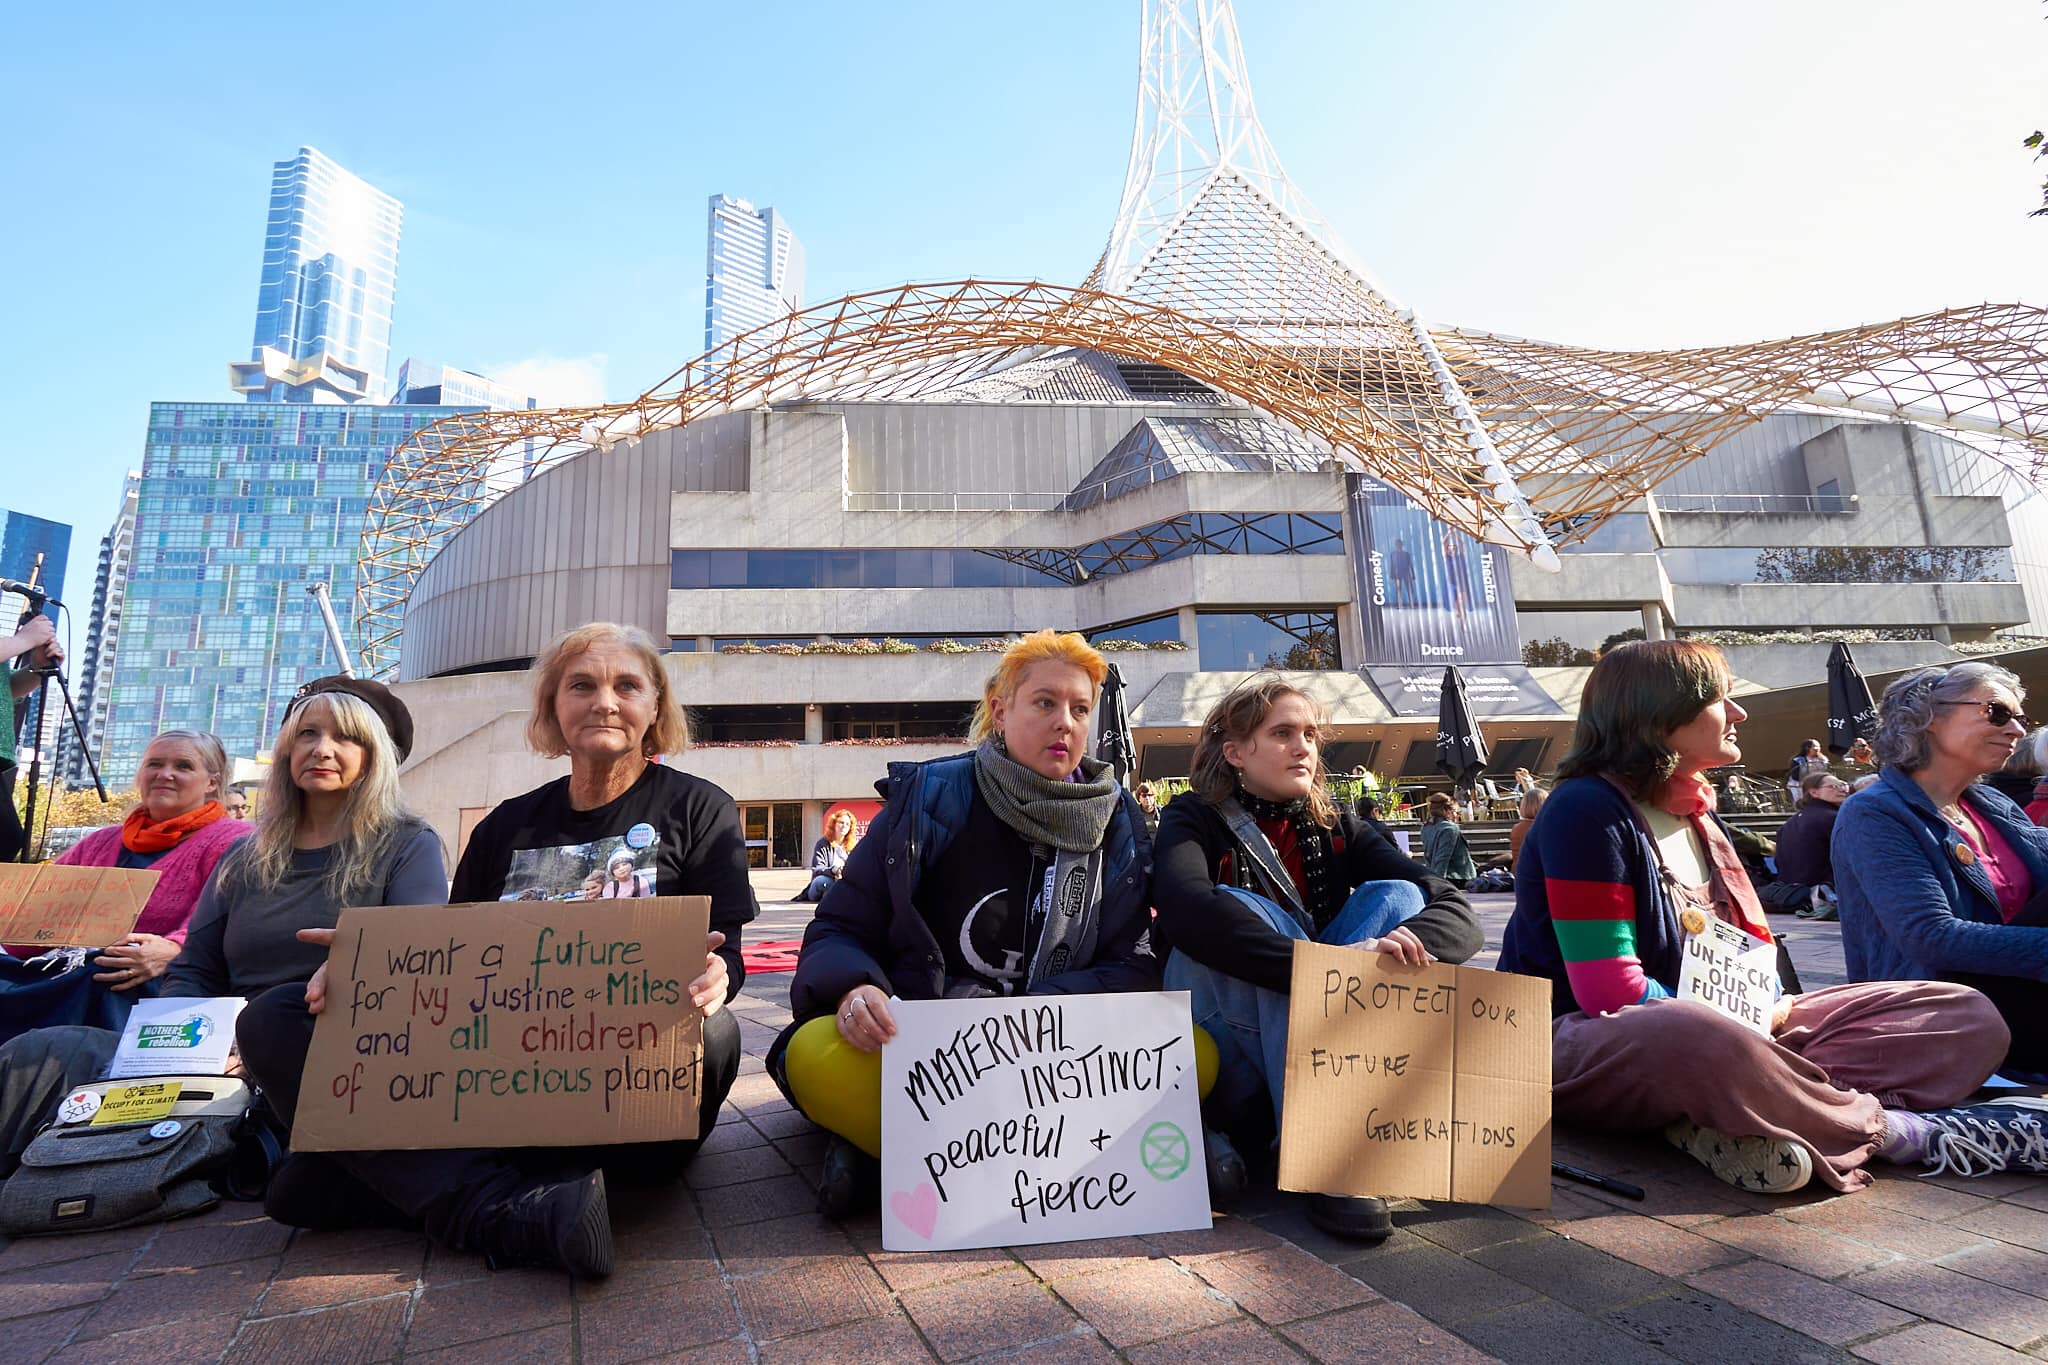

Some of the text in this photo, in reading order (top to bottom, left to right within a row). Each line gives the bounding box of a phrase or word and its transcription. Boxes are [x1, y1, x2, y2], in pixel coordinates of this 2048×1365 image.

[1368, 550, 1386, 606] Comedy
[1480, 551, 1496, 603] Theatre
[1420, 643, 1464, 656] Dance
[350, 926, 645, 991] I want a future
[1708, 968, 1748, 1000] OUR
[349, 980, 399, 1029] for
[411, 978, 450, 1027] Ivy
[468, 972, 576, 1014] Justine
[606, 970, 681, 1007] Miles
[1323, 968, 1518, 1029] PROTECT OUR
[1691, 976, 1762, 1026] FUTURE
[143, 1025, 185, 1036] MOTHERS
[148, 1036, 192, 1048] rebellion
[356, 1012, 659, 1057] and all children
[332, 1050, 703, 1122] of our precious planet
[904, 1004, 1075, 1122] MATERNAL
[1020, 1035, 1184, 1110] INSTINCT:
[1311, 1047, 1411, 1078] FUTURE
[65, 1099, 74, 1109] I
[103, 1095, 176, 1110] OCCUPY FOR CLIMATE
[1365, 1107, 1516, 1148] GENERATIONS
[923, 1114, 1113, 1204] peaceful +
[1011, 1168, 1138, 1224] fierce
